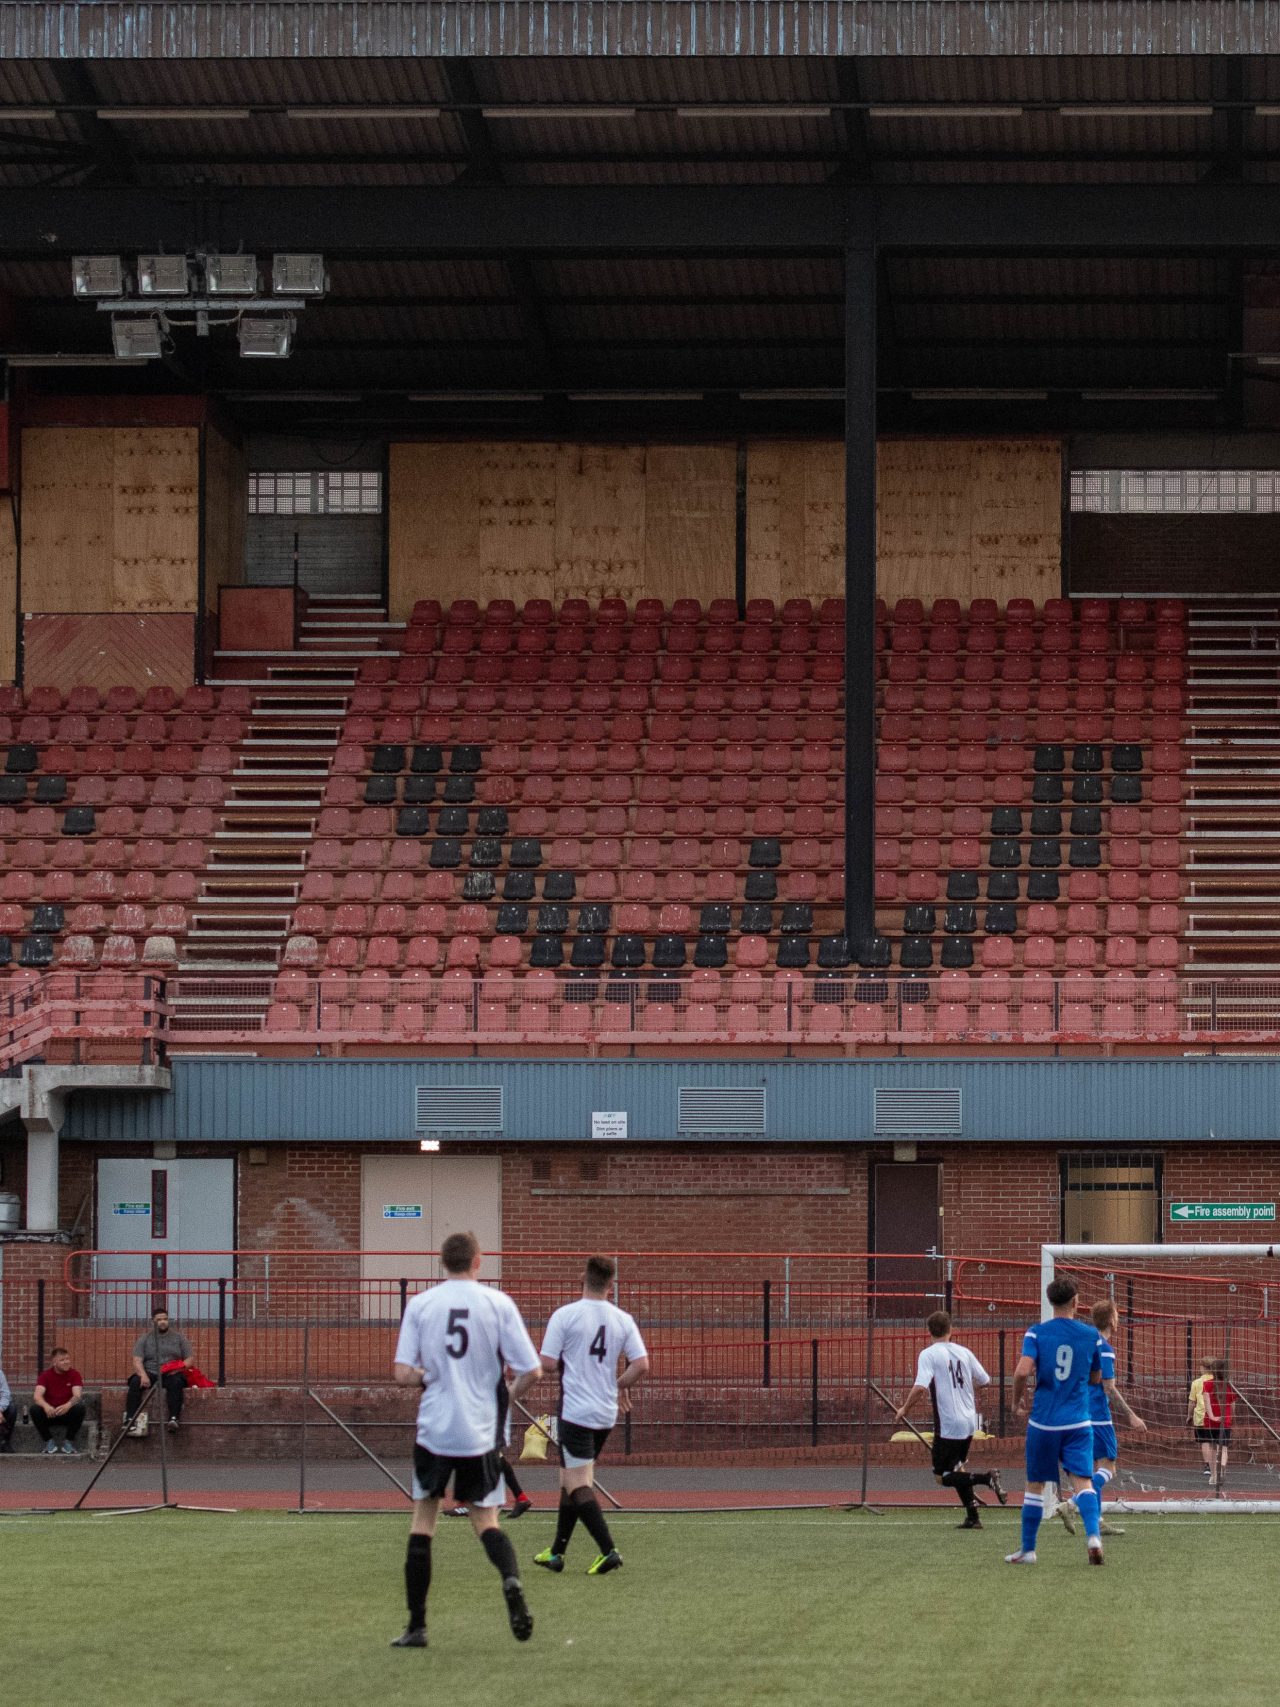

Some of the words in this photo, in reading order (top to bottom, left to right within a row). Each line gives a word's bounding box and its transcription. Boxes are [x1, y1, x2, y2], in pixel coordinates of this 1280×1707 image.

[1195, 1205, 1210, 1216] Fire
[1213, 1206, 1251, 1219] assembly
[1253, 1206, 1274, 1219] point
[446, 1308, 469, 1360] 5
[589, 1325, 607, 1363] 4
[949, 1359, 964, 1389] 14
[1055, 1344, 1073, 1381] 9
